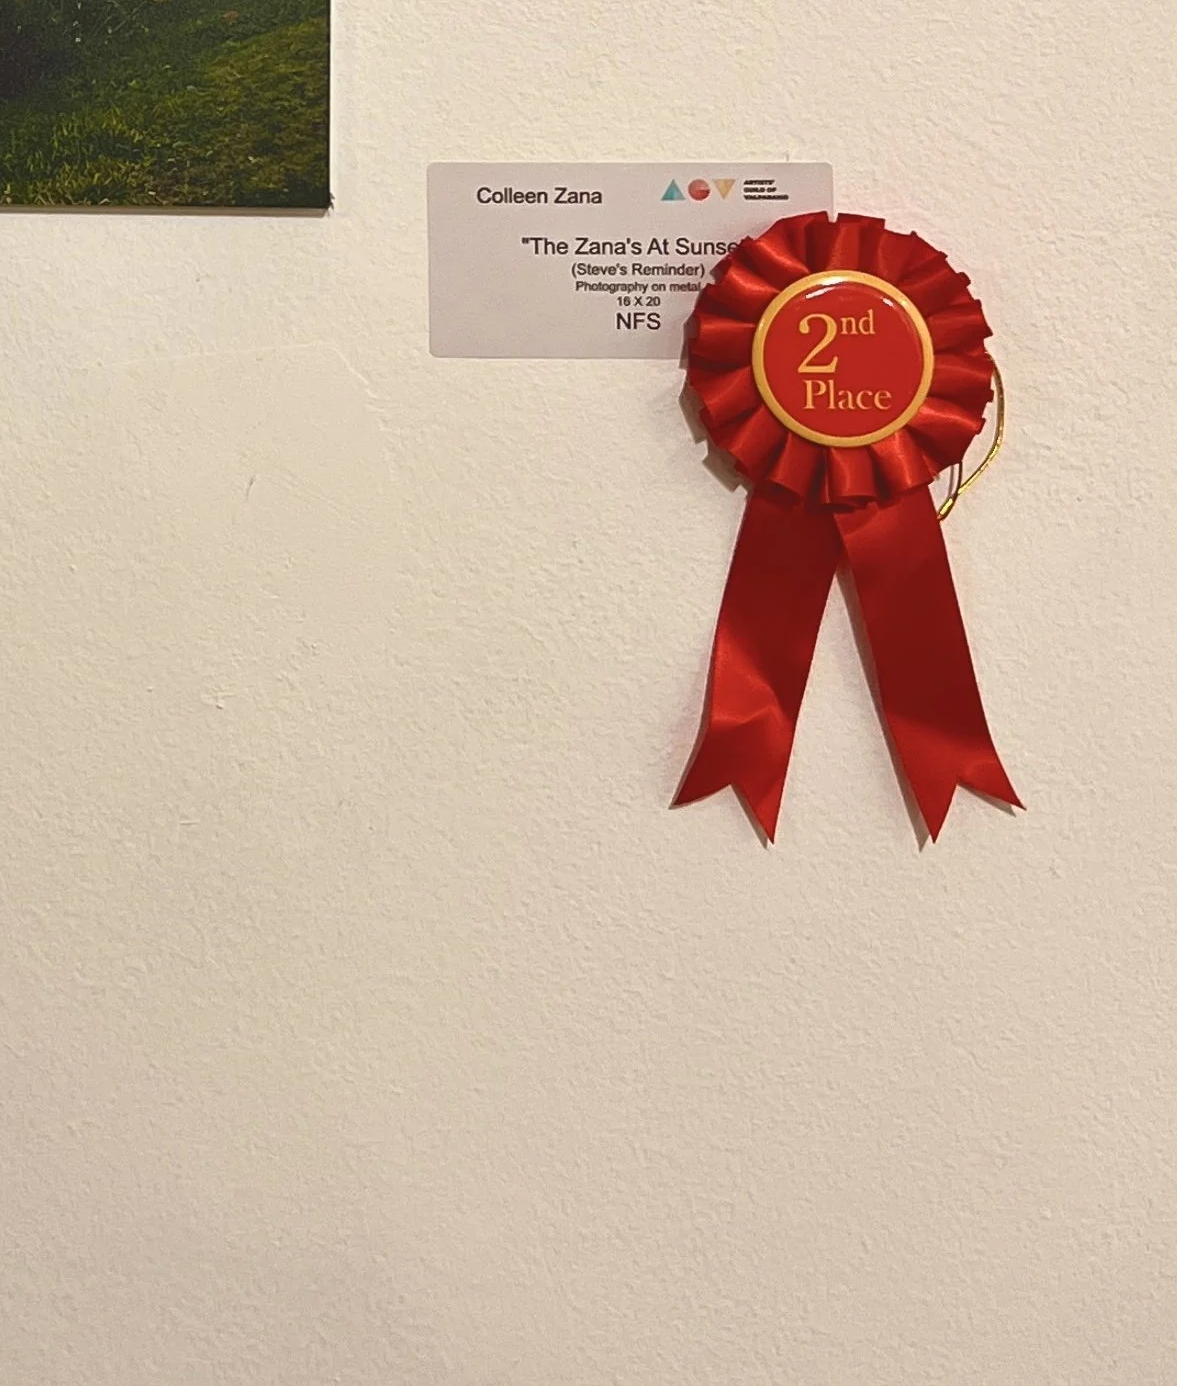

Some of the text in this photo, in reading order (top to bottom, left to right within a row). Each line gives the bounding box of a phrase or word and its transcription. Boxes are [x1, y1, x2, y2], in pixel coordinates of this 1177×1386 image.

[476, 186, 603, 204] Colleen Zana
[521, 237, 739, 255] "The Zana's At Sunse
[571, 263, 705, 278] (Steve's Reminder)
[575, 281, 701, 294] Photography on metal
[617, 296, 661, 307] 16 X 20
[616, 312, 661, 330] NFS
[797, 309, 875, 374] 2nd
[803, 379, 892, 410] Place
